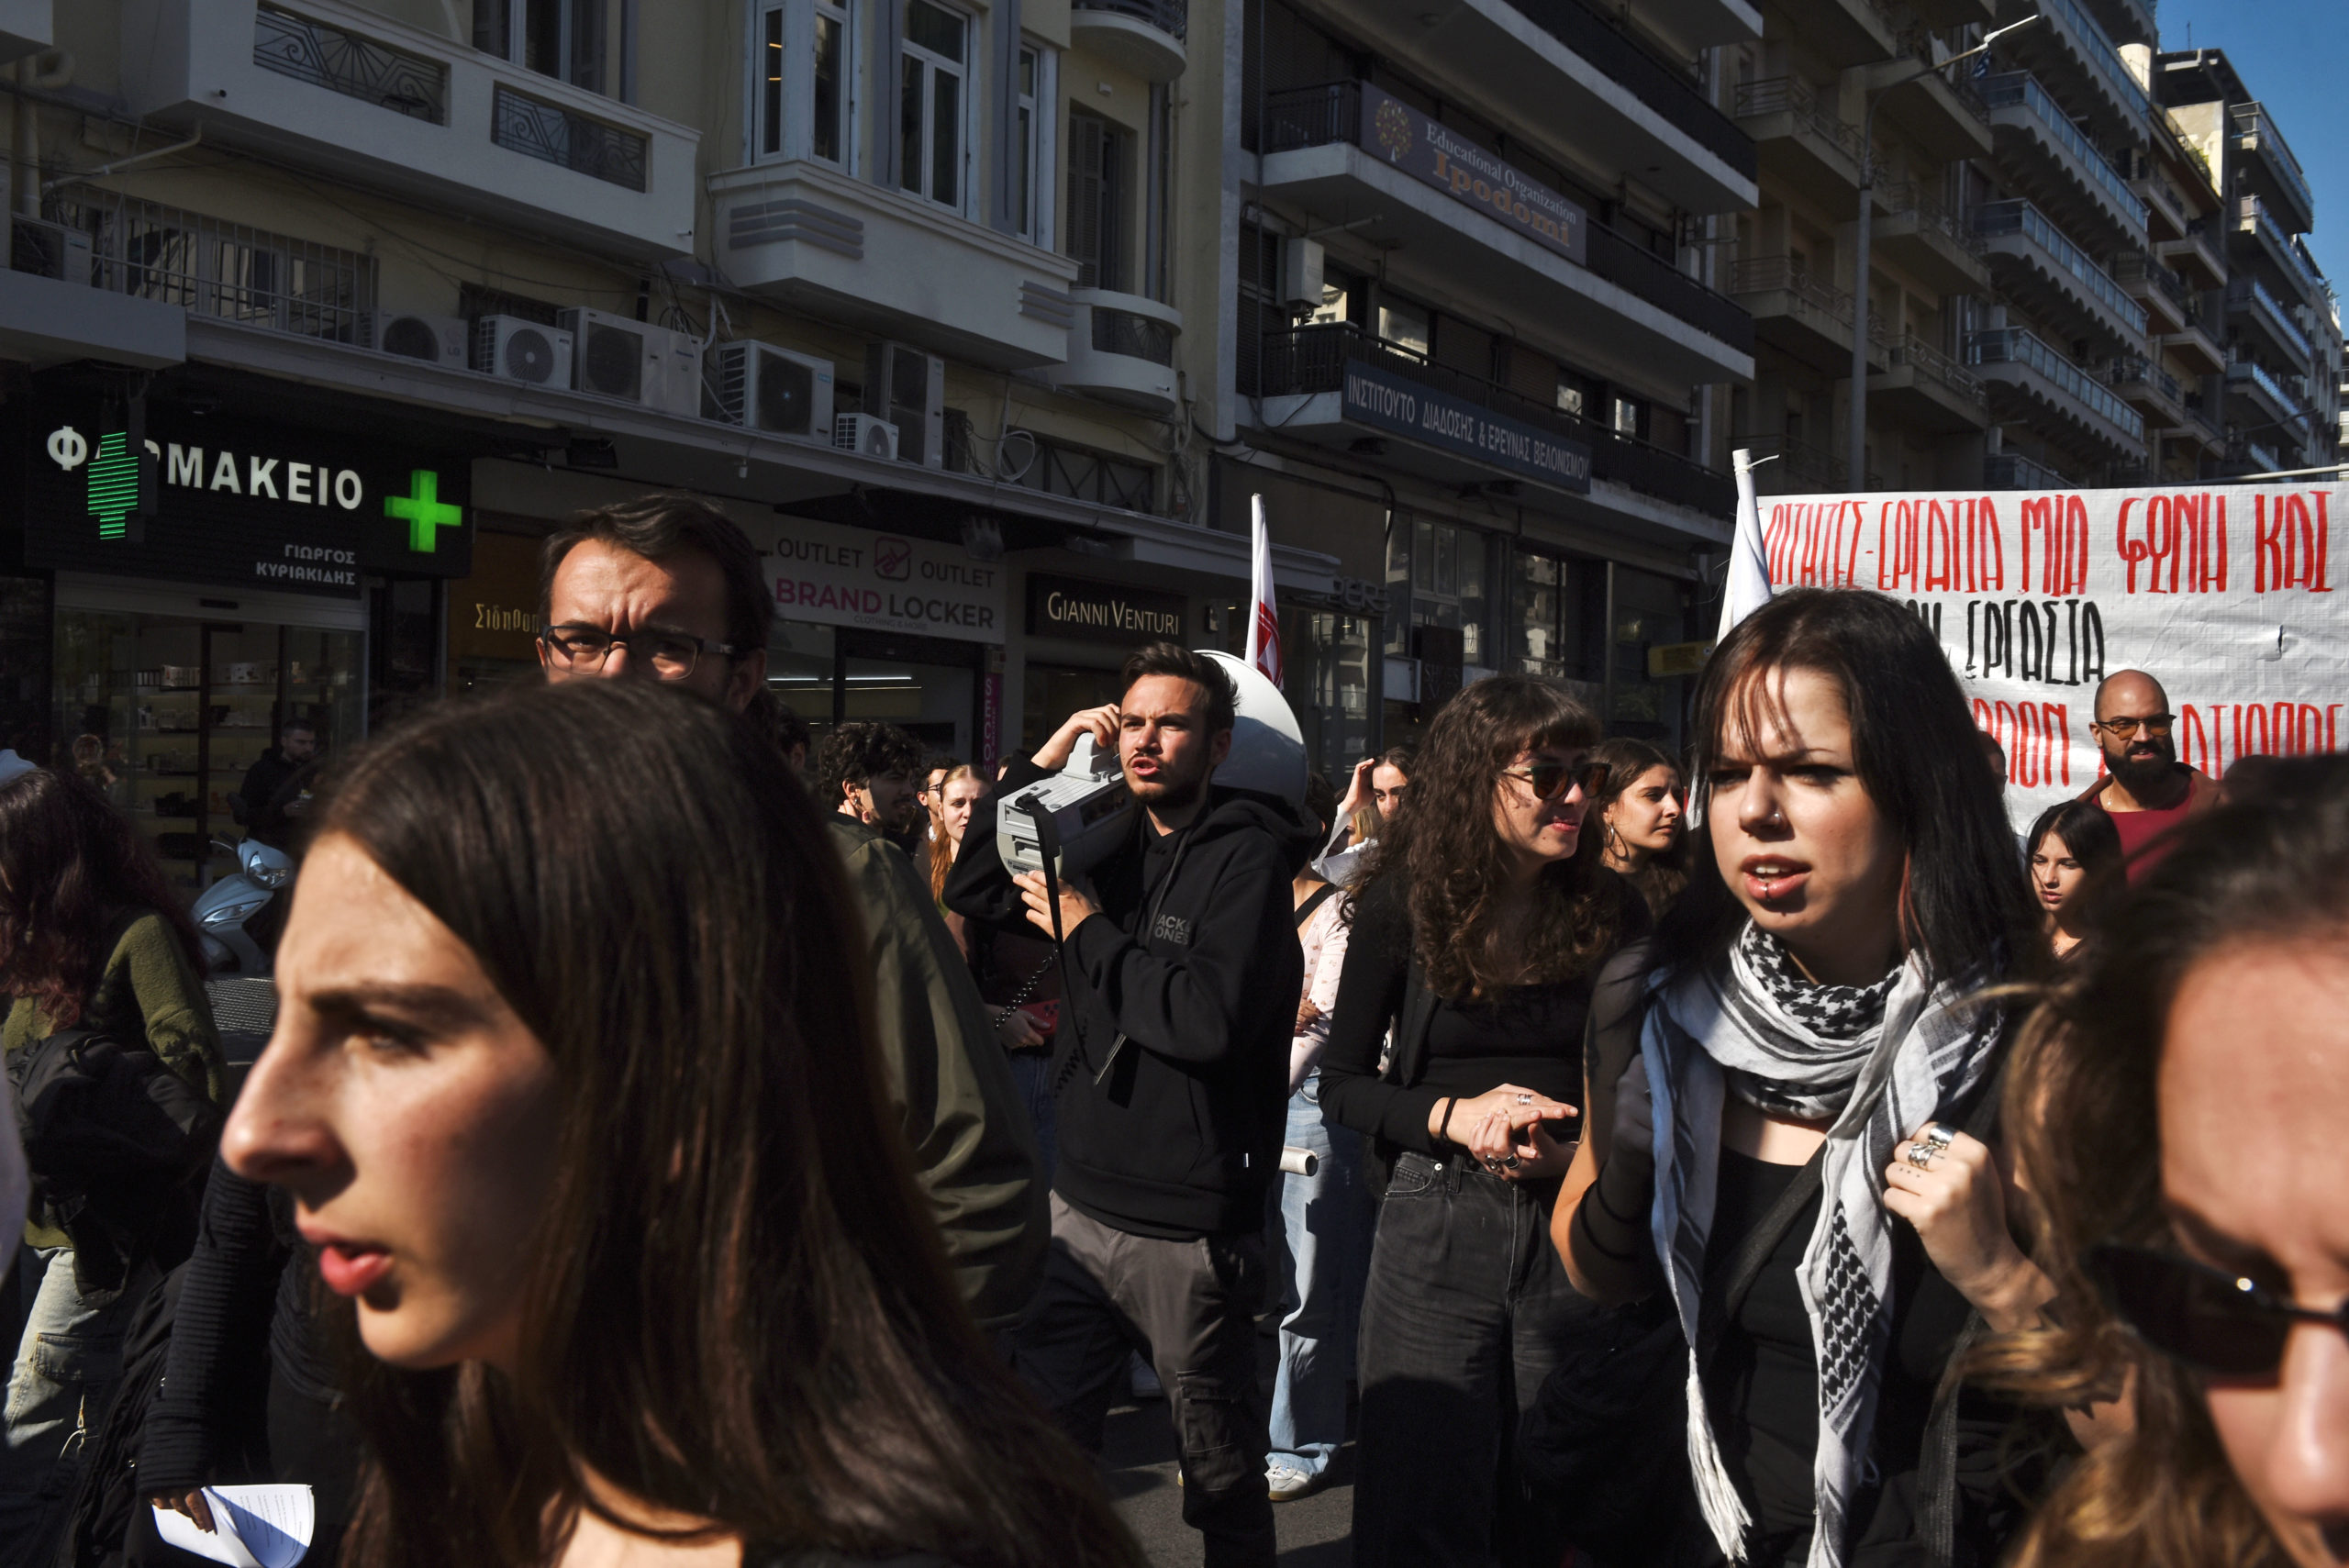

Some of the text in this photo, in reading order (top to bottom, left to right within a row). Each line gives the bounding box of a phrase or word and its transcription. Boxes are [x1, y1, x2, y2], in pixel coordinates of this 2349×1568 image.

[1426, 122, 1576, 225] Educational Organization
[1432, 149, 1570, 247] Ipodomi
[1348, 374, 1590, 482] ΙΝΣΤΙΤΟΥΤΟ ΔΙΑΔΟΣΗΣ & ΕΡΕΥΝΑΣ ΒΕΛΟΝΙΣΜΟΥ
[47, 425, 362, 510] ΦΜΑΚΕΙΟ
[284, 544, 355, 564] ΓΙΩΡΓΟΣ
[777, 538, 863, 569] OUTLET
[2021, 494, 2088, 597] ΜΙΑ
[2254, 490, 2334, 594] ΚΑΙ
[256, 562, 356, 585] ΚΥΡΙΑΚΙΔΗΣ
[920, 561, 996, 588] OUTLET
[776, 578, 994, 628] BRAND LOCKER
[853, 616, 896, 628] CLOTHING
[1047, 591, 1179, 636] GIANNI VENTURI
[1965, 599, 2105, 686] ΕΡΓΑΣΙΑ
[1154, 926, 1190, 946] ONES
